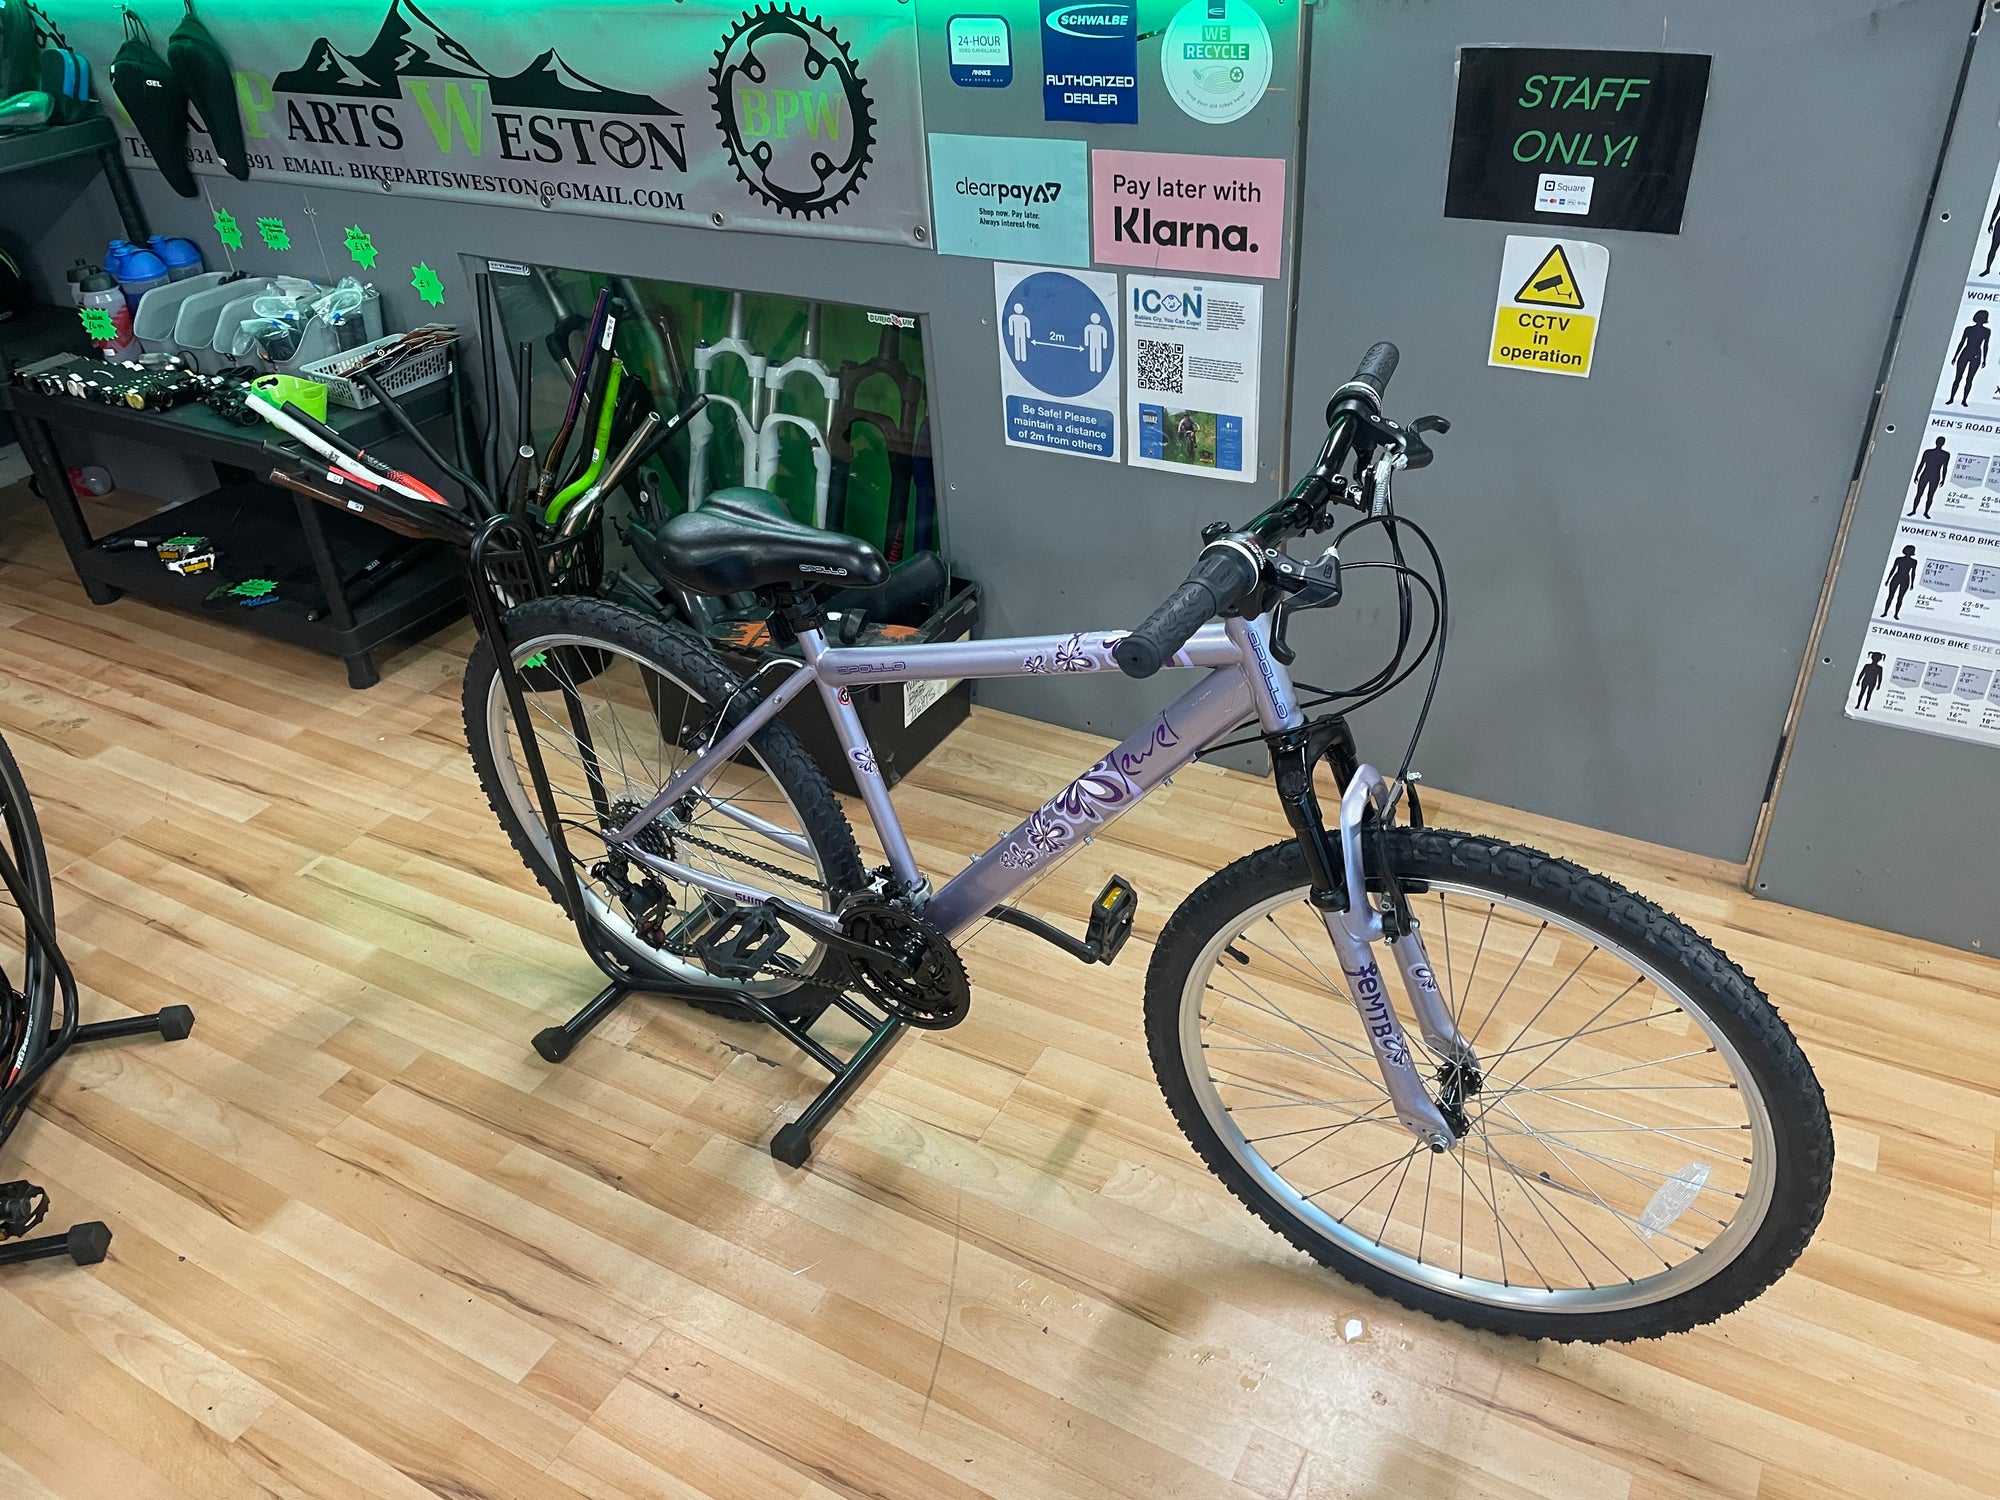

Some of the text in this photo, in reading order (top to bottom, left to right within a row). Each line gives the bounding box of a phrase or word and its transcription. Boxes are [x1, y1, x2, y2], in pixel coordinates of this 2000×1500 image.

[1060, 14, 1129, 26] SCHWALBE
[958, 35, 1001, 47] 24-HOUR
[1204, 26, 1229, 41] WE
[1186, 44, 1248, 59] RECYCLE
[146, 79, 162, 88] GEL
[1046, 74, 1135, 88] AUTHORIZED
[1064, 92, 1118, 106] DEALER
[1518, 74, 1651, 111] STAFF
[737, 88, 842, 141] BPW
[1512, 130, 1638, 168] ONLY!
[283, 156, 344, 177] EMAIL:
[348, 162, 686, 211] BIKEPARTSWESTON@GMAIL.COM
[955, 176, 1034, 207] clearpay
[1113, 174, 1262, 203] Pay later with
[1557, 182, 1586, 193] Square
[979, 207, 1040, 220] Shop now. Pay later.
[979, 218, 1000, 228] Always
[1113, 206, 1259, 254] Klarna.
[1967, 291, 2000, 303] WOME
[1518, 313, 1571, 332] CCTV
[1049, 331, 1065, 342] 2m
[1532, 330, 1549, 346] in
[1500, 345, 1582, 367] operation
[1022, 404, 1098, 425] Be Safe! Please
[1013, 416, 1107, 440] maintain a distance
[1931, 418, 1963, 429] MEN'S
[1965, 422, 1993, 434] ROAD
[1018, 430, 1103, 452] of 2m from others
[1980, 501, 1990, 509] XS
[1901, 525, 2000, 548] WOMEN'S ROAD BIKE
[1871, 626, 1922, 641] STANDARD
[1923, 635, 1946, 646] KIDS
[1947, 640, 1971, 650] BIKE
[1972, 644, 1994, 655] SIZE
[837, 661, 906, 675] APOLLO
[1248, 630, 1289, 719] APOLLO
[735, 892, 764, 907] SHIM
